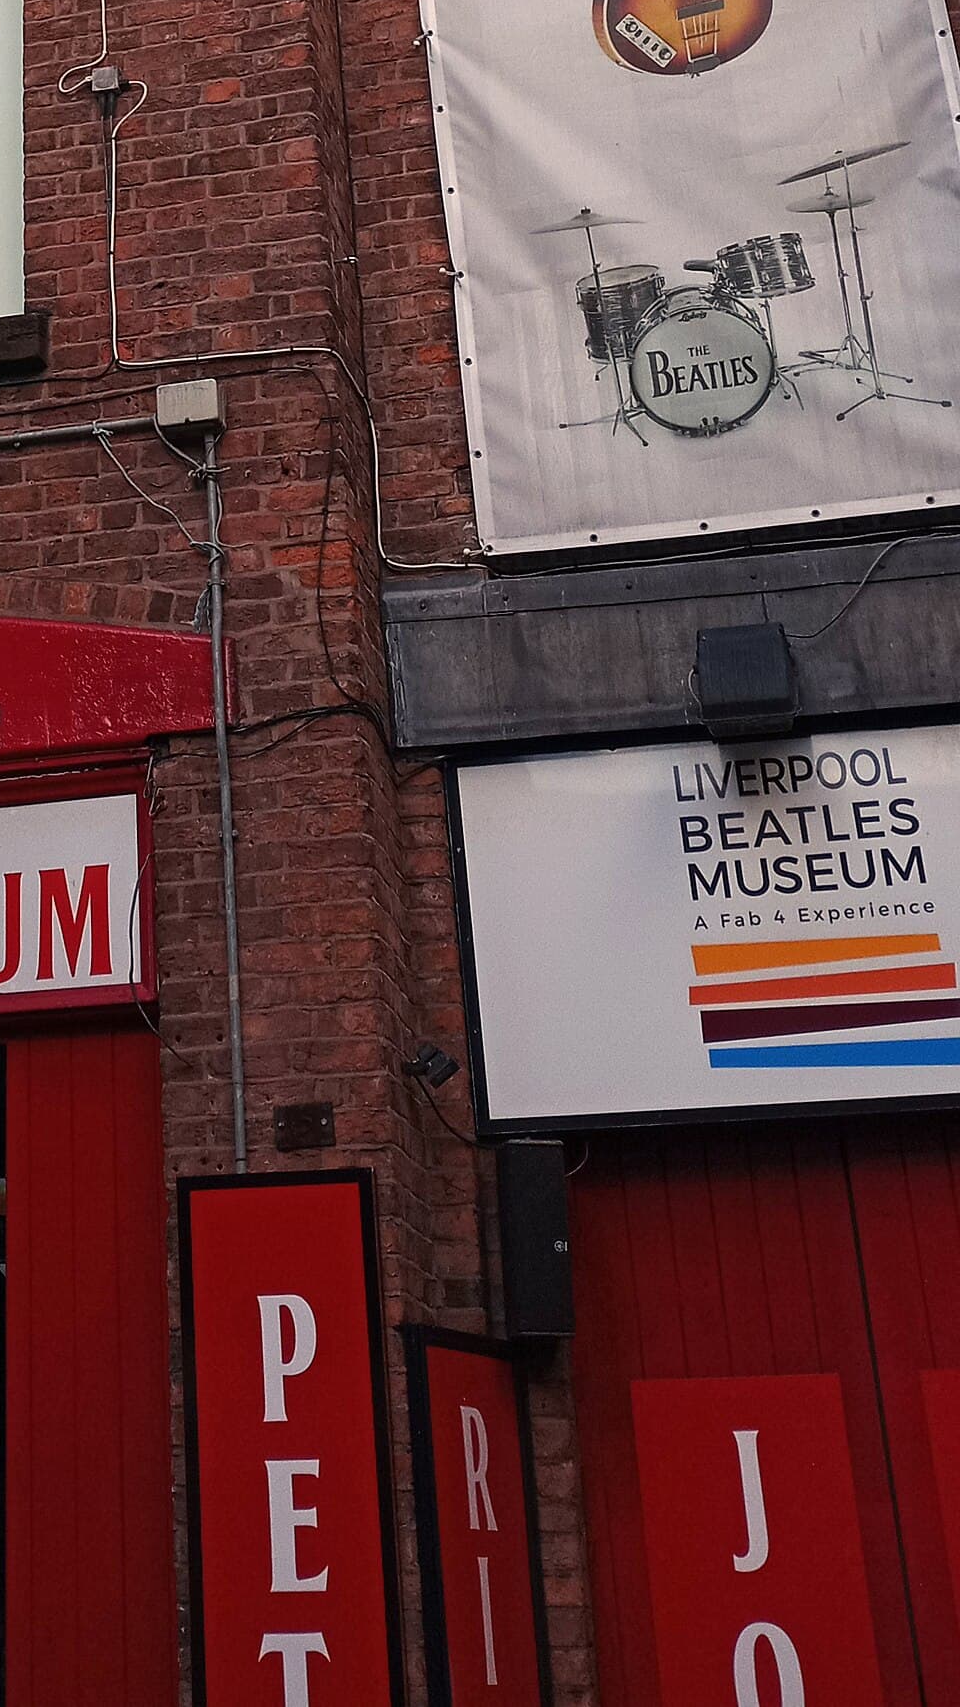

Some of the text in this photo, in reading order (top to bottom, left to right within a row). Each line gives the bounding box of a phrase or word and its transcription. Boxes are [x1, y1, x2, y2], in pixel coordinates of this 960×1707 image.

[646, 350, 758, 398] BEATLES
[686, 345, 711, 357] THE
[672, 747, 908, 803] LIVERPOOL
[678, 797, 921, 854] BEATLES
[687, 846, 928, 901] MUSEUM
[694, 899, 937, 931] A Fab 4 Experience
